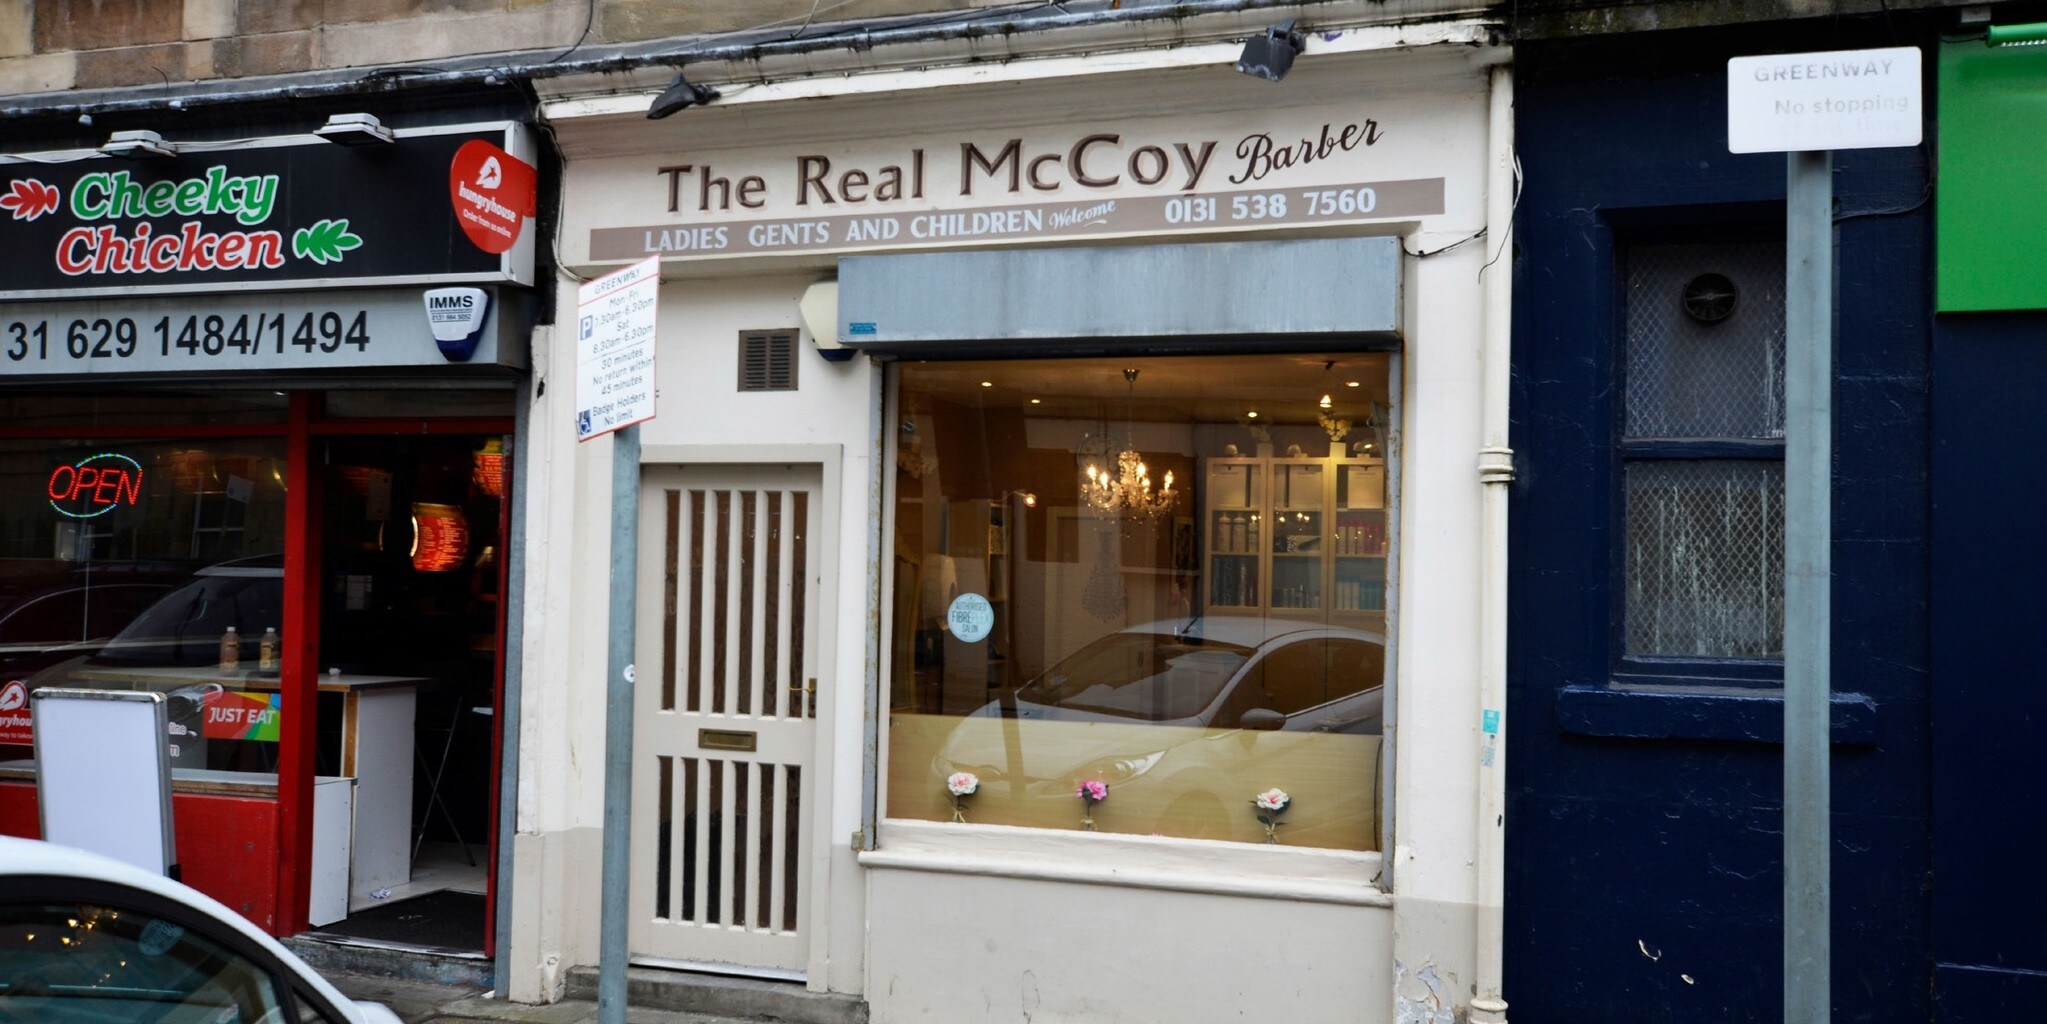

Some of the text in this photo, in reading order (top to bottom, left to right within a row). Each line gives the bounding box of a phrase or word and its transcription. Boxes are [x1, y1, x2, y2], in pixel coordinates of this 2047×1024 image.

[1754, 59, 1893, 82] GREENWAY
[1774, 94, 1909, 115] No stopping
[657, 117, 1385, 213] The Real McCoy Barber
[71, 165, 279, 226] Cheeky
[459, 180, 517, 223] hungryhouse
[644, 187, 1376, 253] LADIES GENTS AND CHILDREN Welcome 0131 538 7560
[56, 221, 285, 276] Chicken
[595, 268, 641, 295] GREENWAY
[430, 295, 473, 309] IMMS
[8, 310, 370, 361] 31 629 1484/1494
[616, 319, 630, 333] Sat
[593, 357, 653, 387] No return within
[601, 347, 644, 370] 30 minutes
[601, 375, 643, 396] 45 minutes
[593, 390, 647, 418] Badge Holders
[604, 408, 634, 427] No limit
[48, 464, 143, 506] OPEN
[208, 706, 277, 725] JUST EAT
